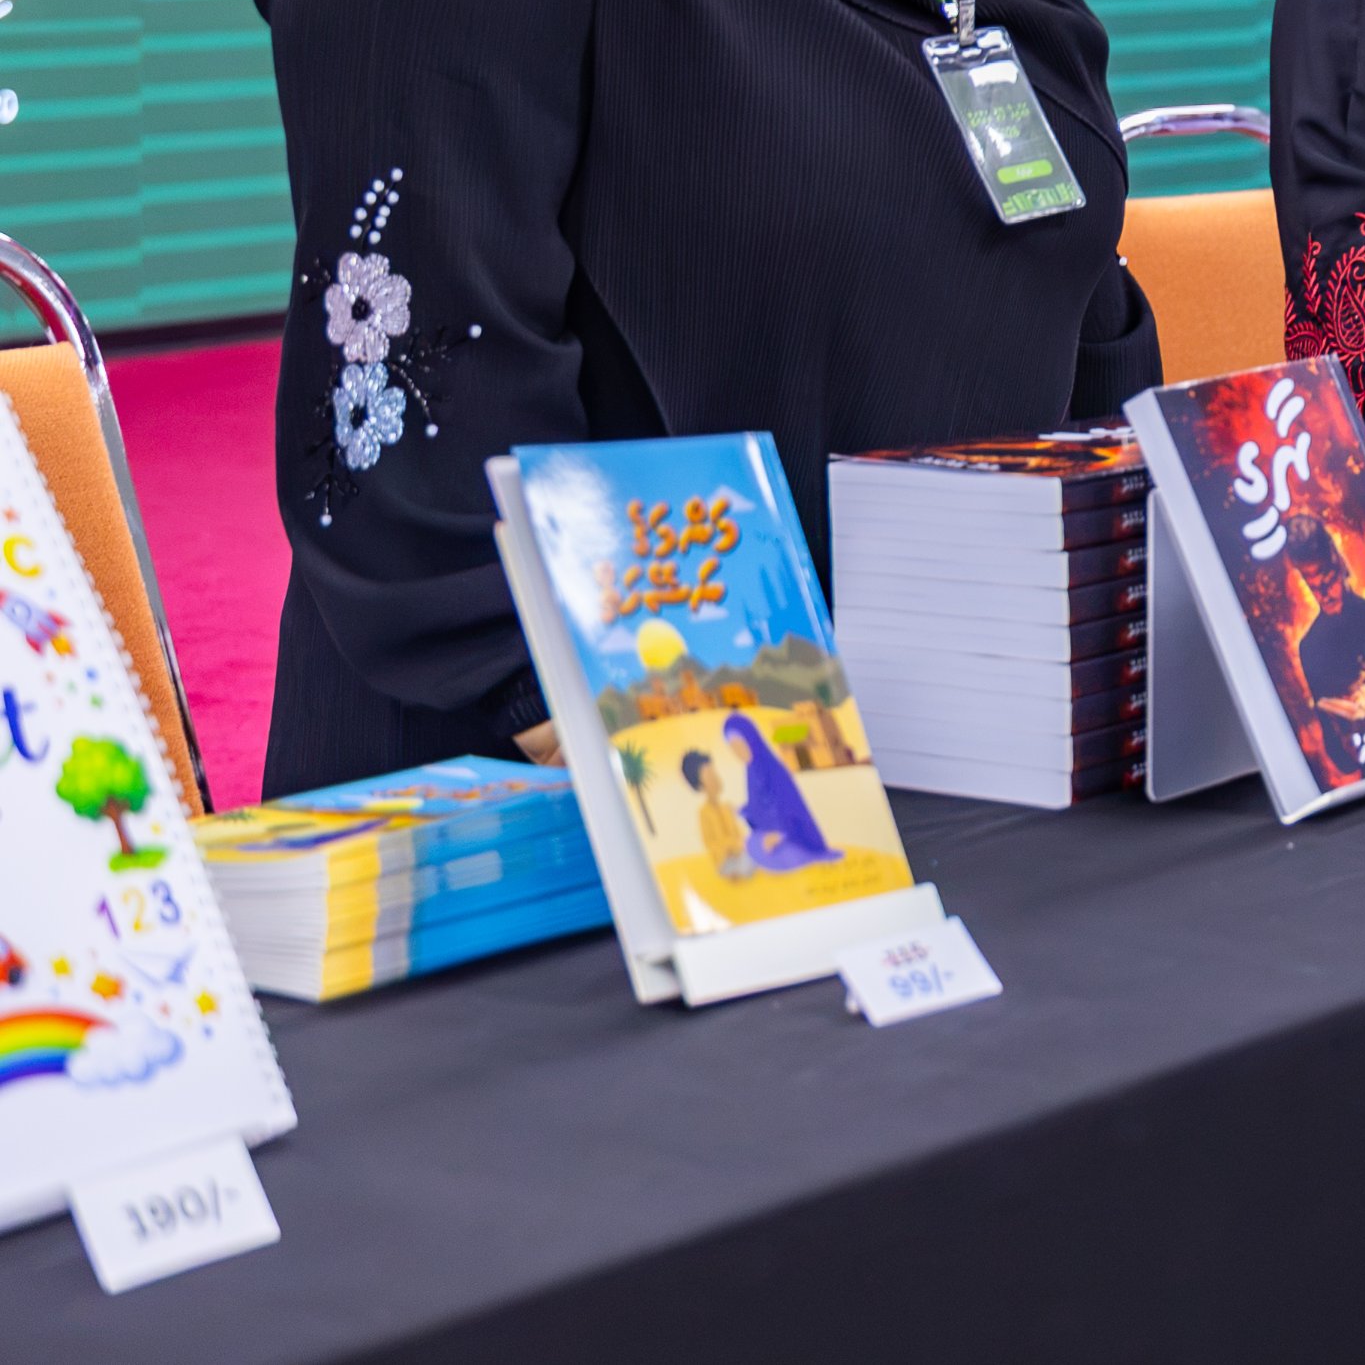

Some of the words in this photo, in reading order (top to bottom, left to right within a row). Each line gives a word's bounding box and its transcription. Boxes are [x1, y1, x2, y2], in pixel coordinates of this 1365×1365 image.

[0, 687, 51, 764] t
[888, 962, 955, 1000] 99/-
[122, 1177, 242, 1244] 190/-
